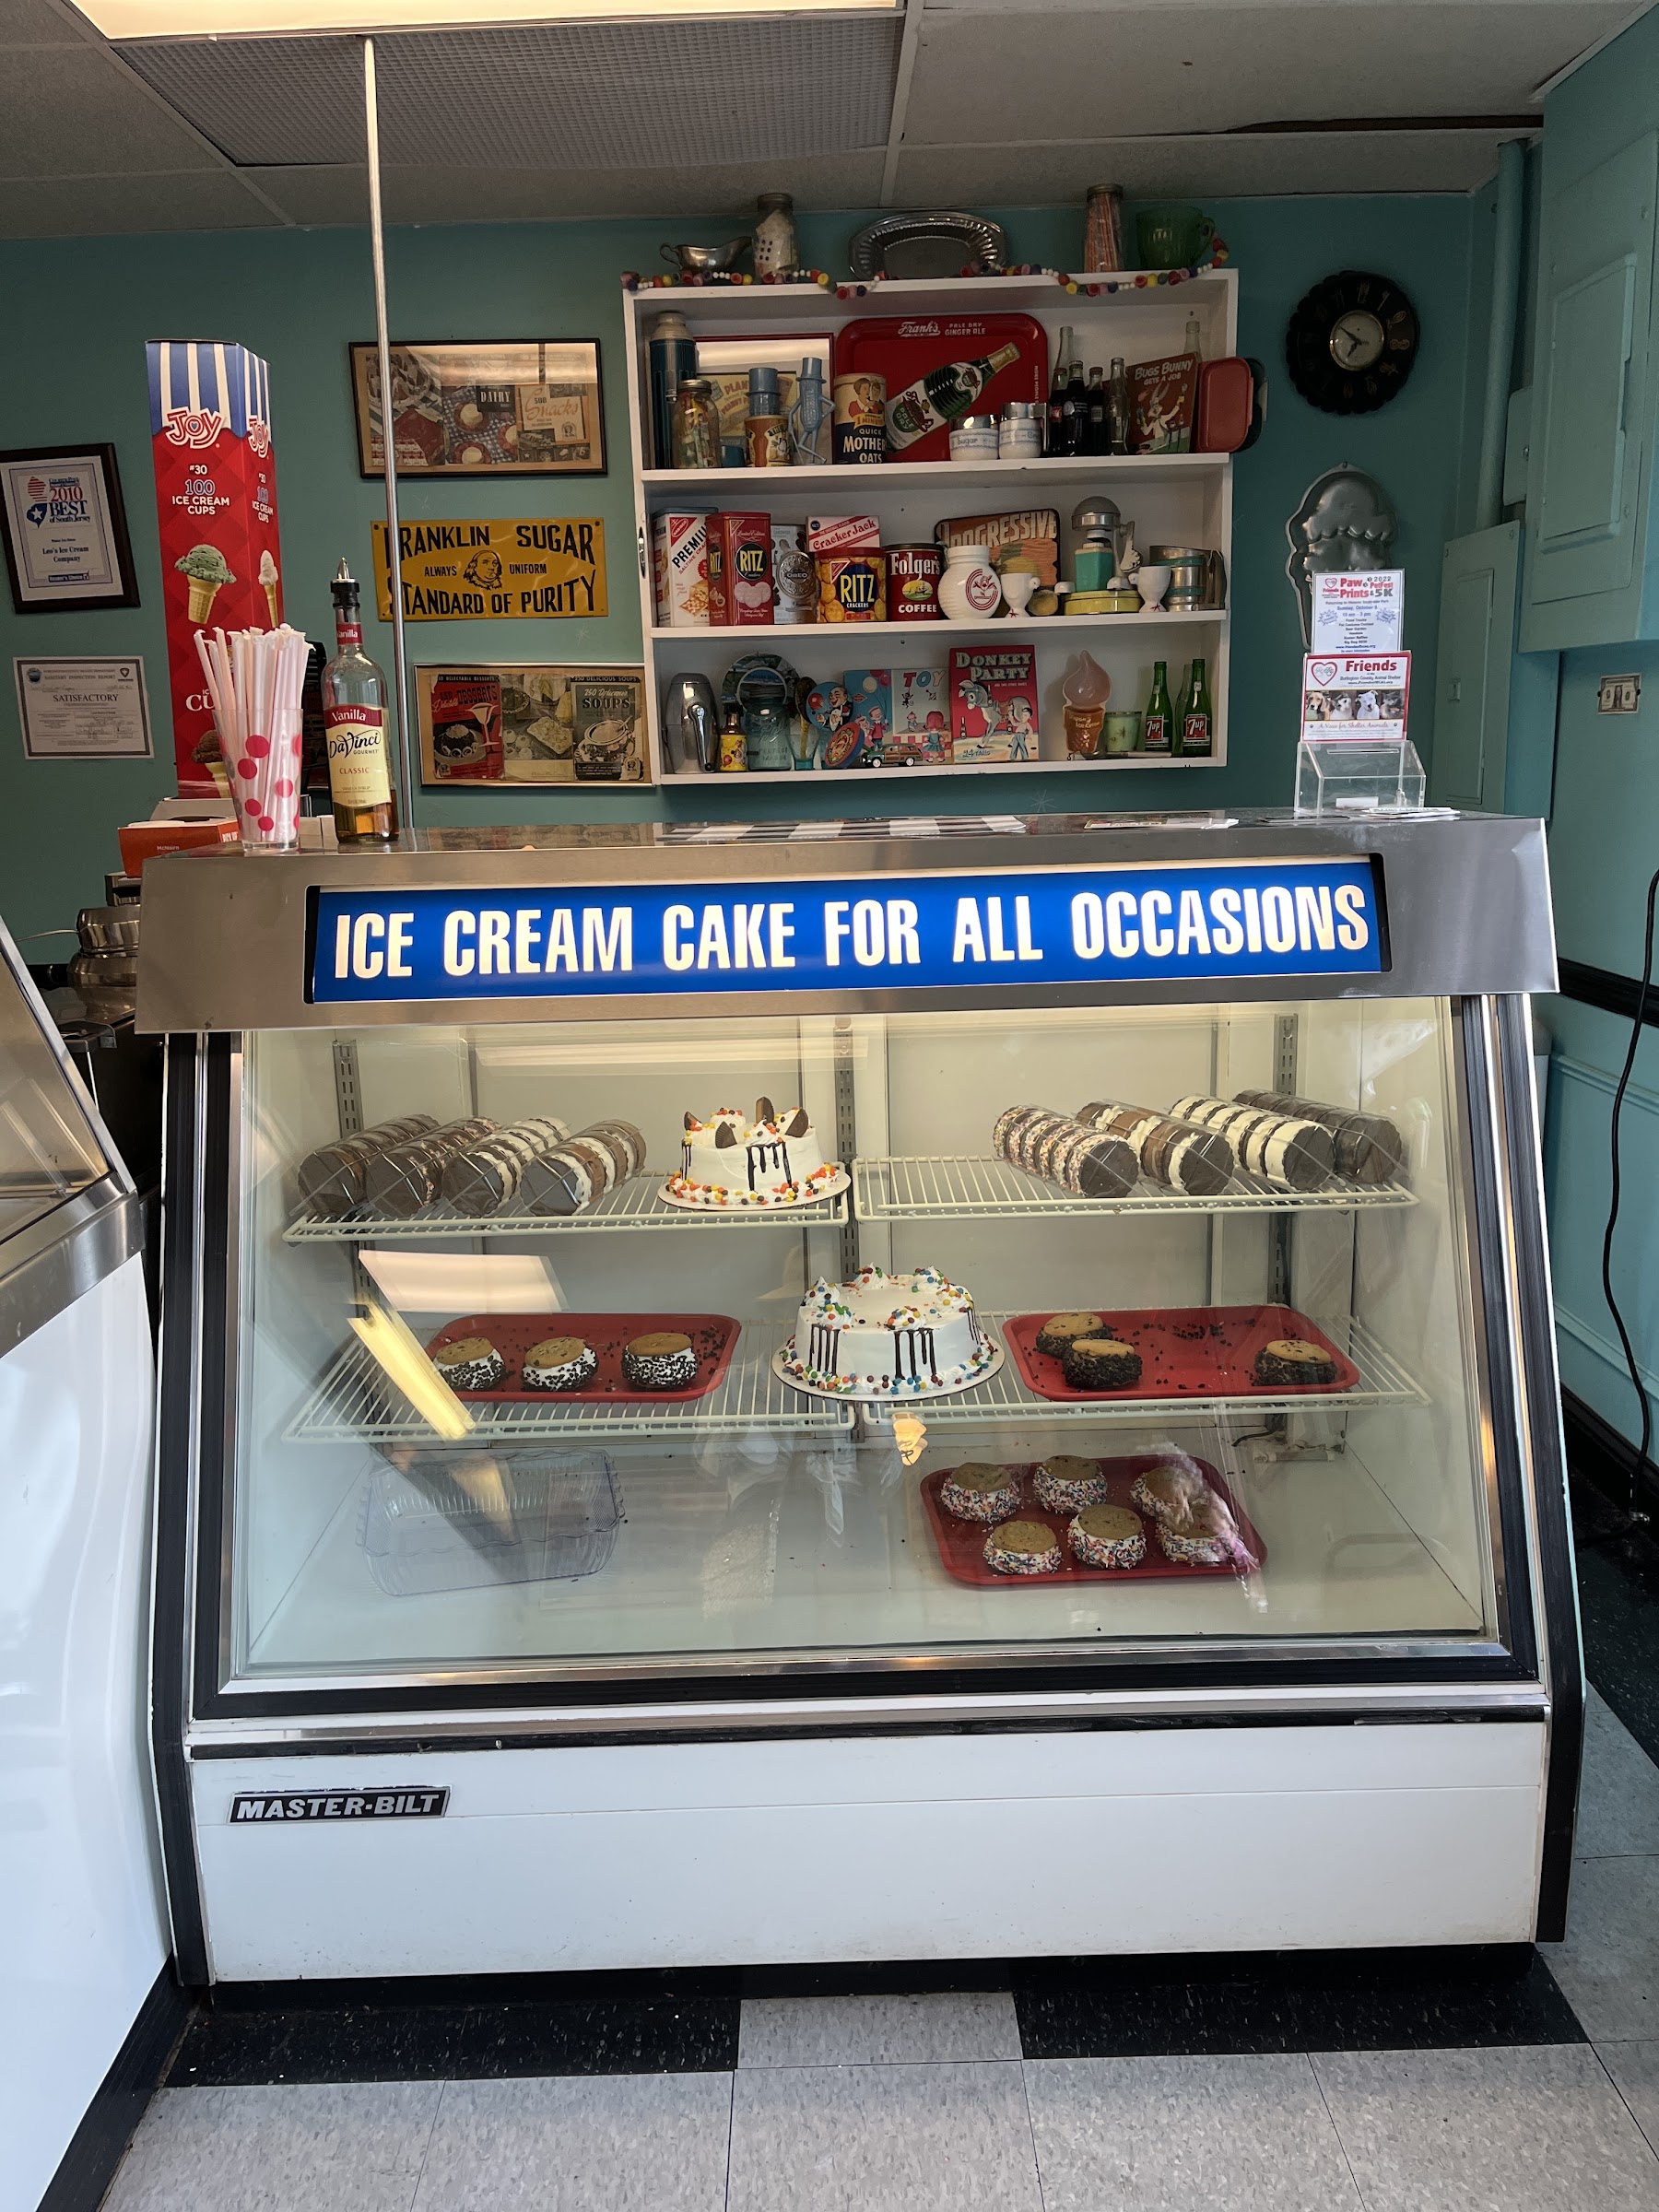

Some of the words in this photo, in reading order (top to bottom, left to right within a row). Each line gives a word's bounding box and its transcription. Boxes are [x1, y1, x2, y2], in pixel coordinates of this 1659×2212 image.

[898, 321, 941, 337] Frank's
[945, 328, 970, 336] GINGER
[1135, 366, 1160, 381] BUGS
[1161, 359, 1194, 375] BUNNY
[1144, 376, 1159, 385] GETS
[1168, 372, 1182, 381] JOB
[724, 380, 748, 394] PLAN
[480, 391, 511, 403] DAIRY
[524, 387, 579, 420] Snacks
[958, 437, 977, 448] Sugar
[859, 453, 882, 464] OATS
[189, 465, 207, 475] #30
[50, 486, 83, 502] 2010
[185, 479, 215, 495] 100
[49, 500, 88, 516] BEST
[172, 496, 189, 504] ICE
[192, 497, 229, 506] CREAM
[252, 500, 260, 512] ICE
[258, 503, 274, 515] CREAM
[187, 505, 216, 515] CUPS
[258, 512, 269, 523] CUPS
[517, 524, 595, 565] SUGAR
[672, 523, 707, 569] PREMIU
[53, 555, 80, 564] Company
[710, 551, 722, 573] RITZ
[740, 550, 763, 571] RITZ
[890, 552, 940, 581] Folger's
[424, 566, 457, 577] ALWAYS
[509, 564, 547, 575] UNIFORM
[840, 574, 875, 603] RITZ
[1340, 578, 1362, 587] Paw
[388, 576, 484, 615] TANDARD
[491, 593, 512, 614] OF
[521, 570, 595, 613] PURITY
[1340, 588, 1369, 598] Prints
[1375, 589, 1393, 597] 5K
[898, 604, 937, 613] COFFEE
[956, 653, 1031, 668] DONKEY
[1346, 660, 1397, 672] Friends
[904, 670, 946, 688] TOY
[970, 666, 1029, 681] PARTY
[53, 694, 119, 702] SATISFACTORY
[186, 694, 215, 711] CU
[582, 698, 631, 709] SOUPS
[332, 709, 366, 722] Vanilla
[329, 729, 381, 758] DaVinci
[335, 912, 414, 979] ICE
[443, 907, 633, 976] CREAM
[663, 902, 795, 971] CAKE
[825, 899, 921, 967] FOR
[953, 895, 1044, 963] ALL
[1071, 884, 1370, 959] OCCASIONS
[236, 1794, 440, 1819] MASTER-BILT
